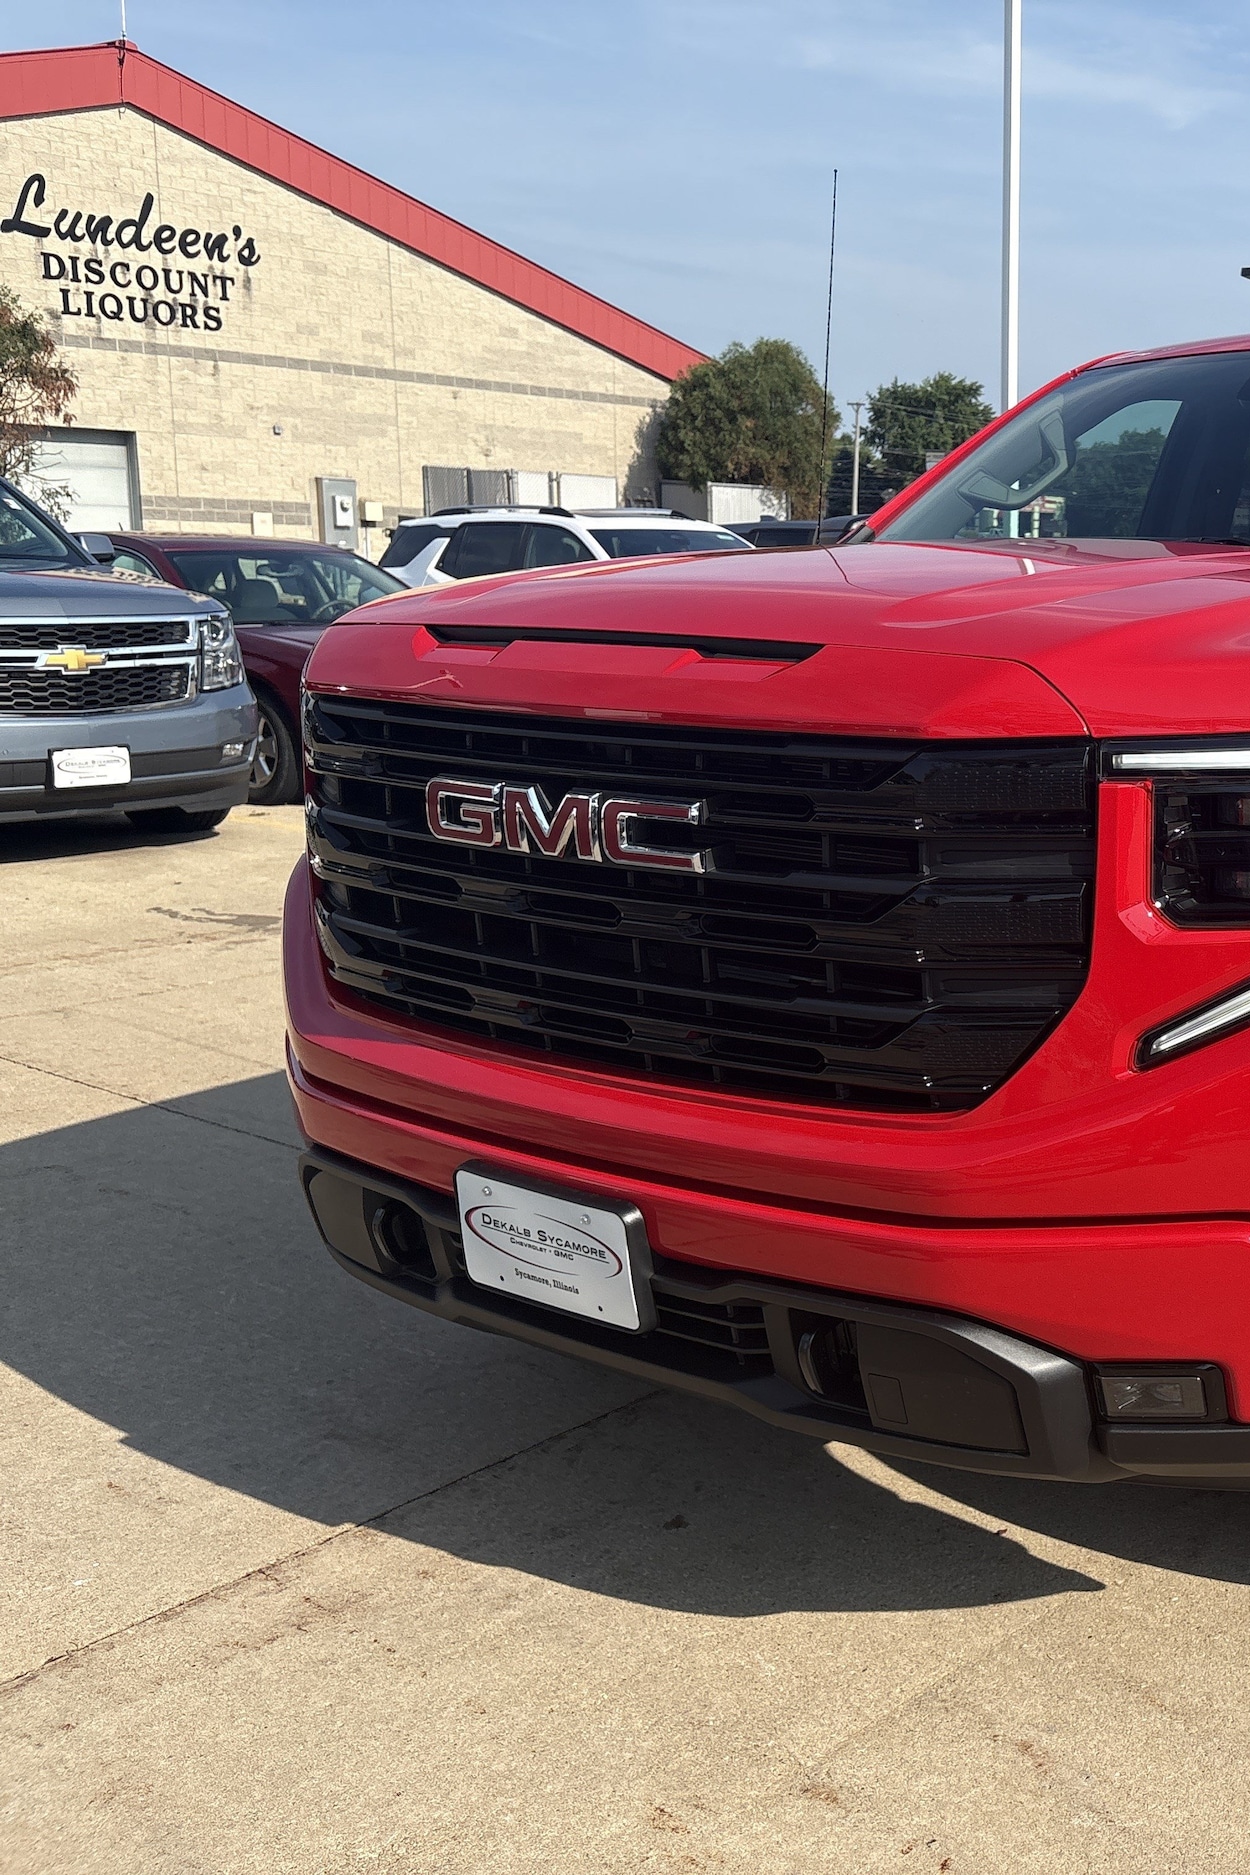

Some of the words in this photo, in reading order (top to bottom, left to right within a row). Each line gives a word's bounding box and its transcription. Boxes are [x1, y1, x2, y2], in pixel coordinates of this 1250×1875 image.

[1, 173, 261, 267] Lundeen's
[41, 252, 235, 301] DISCOUNT
[59, 288, 223, 331] LIQUORS
[425, 776, 707, 874] GMC
[510, 1237, 547, 1253] CHEVROLET
[554, 1250, 575, 1261] GMC
[537, 1230, 607, 1260] SYCAMORE
[514, 1267, 552, 1288] Sycamore,
[552, 1279, 580, 1295] Illinois
